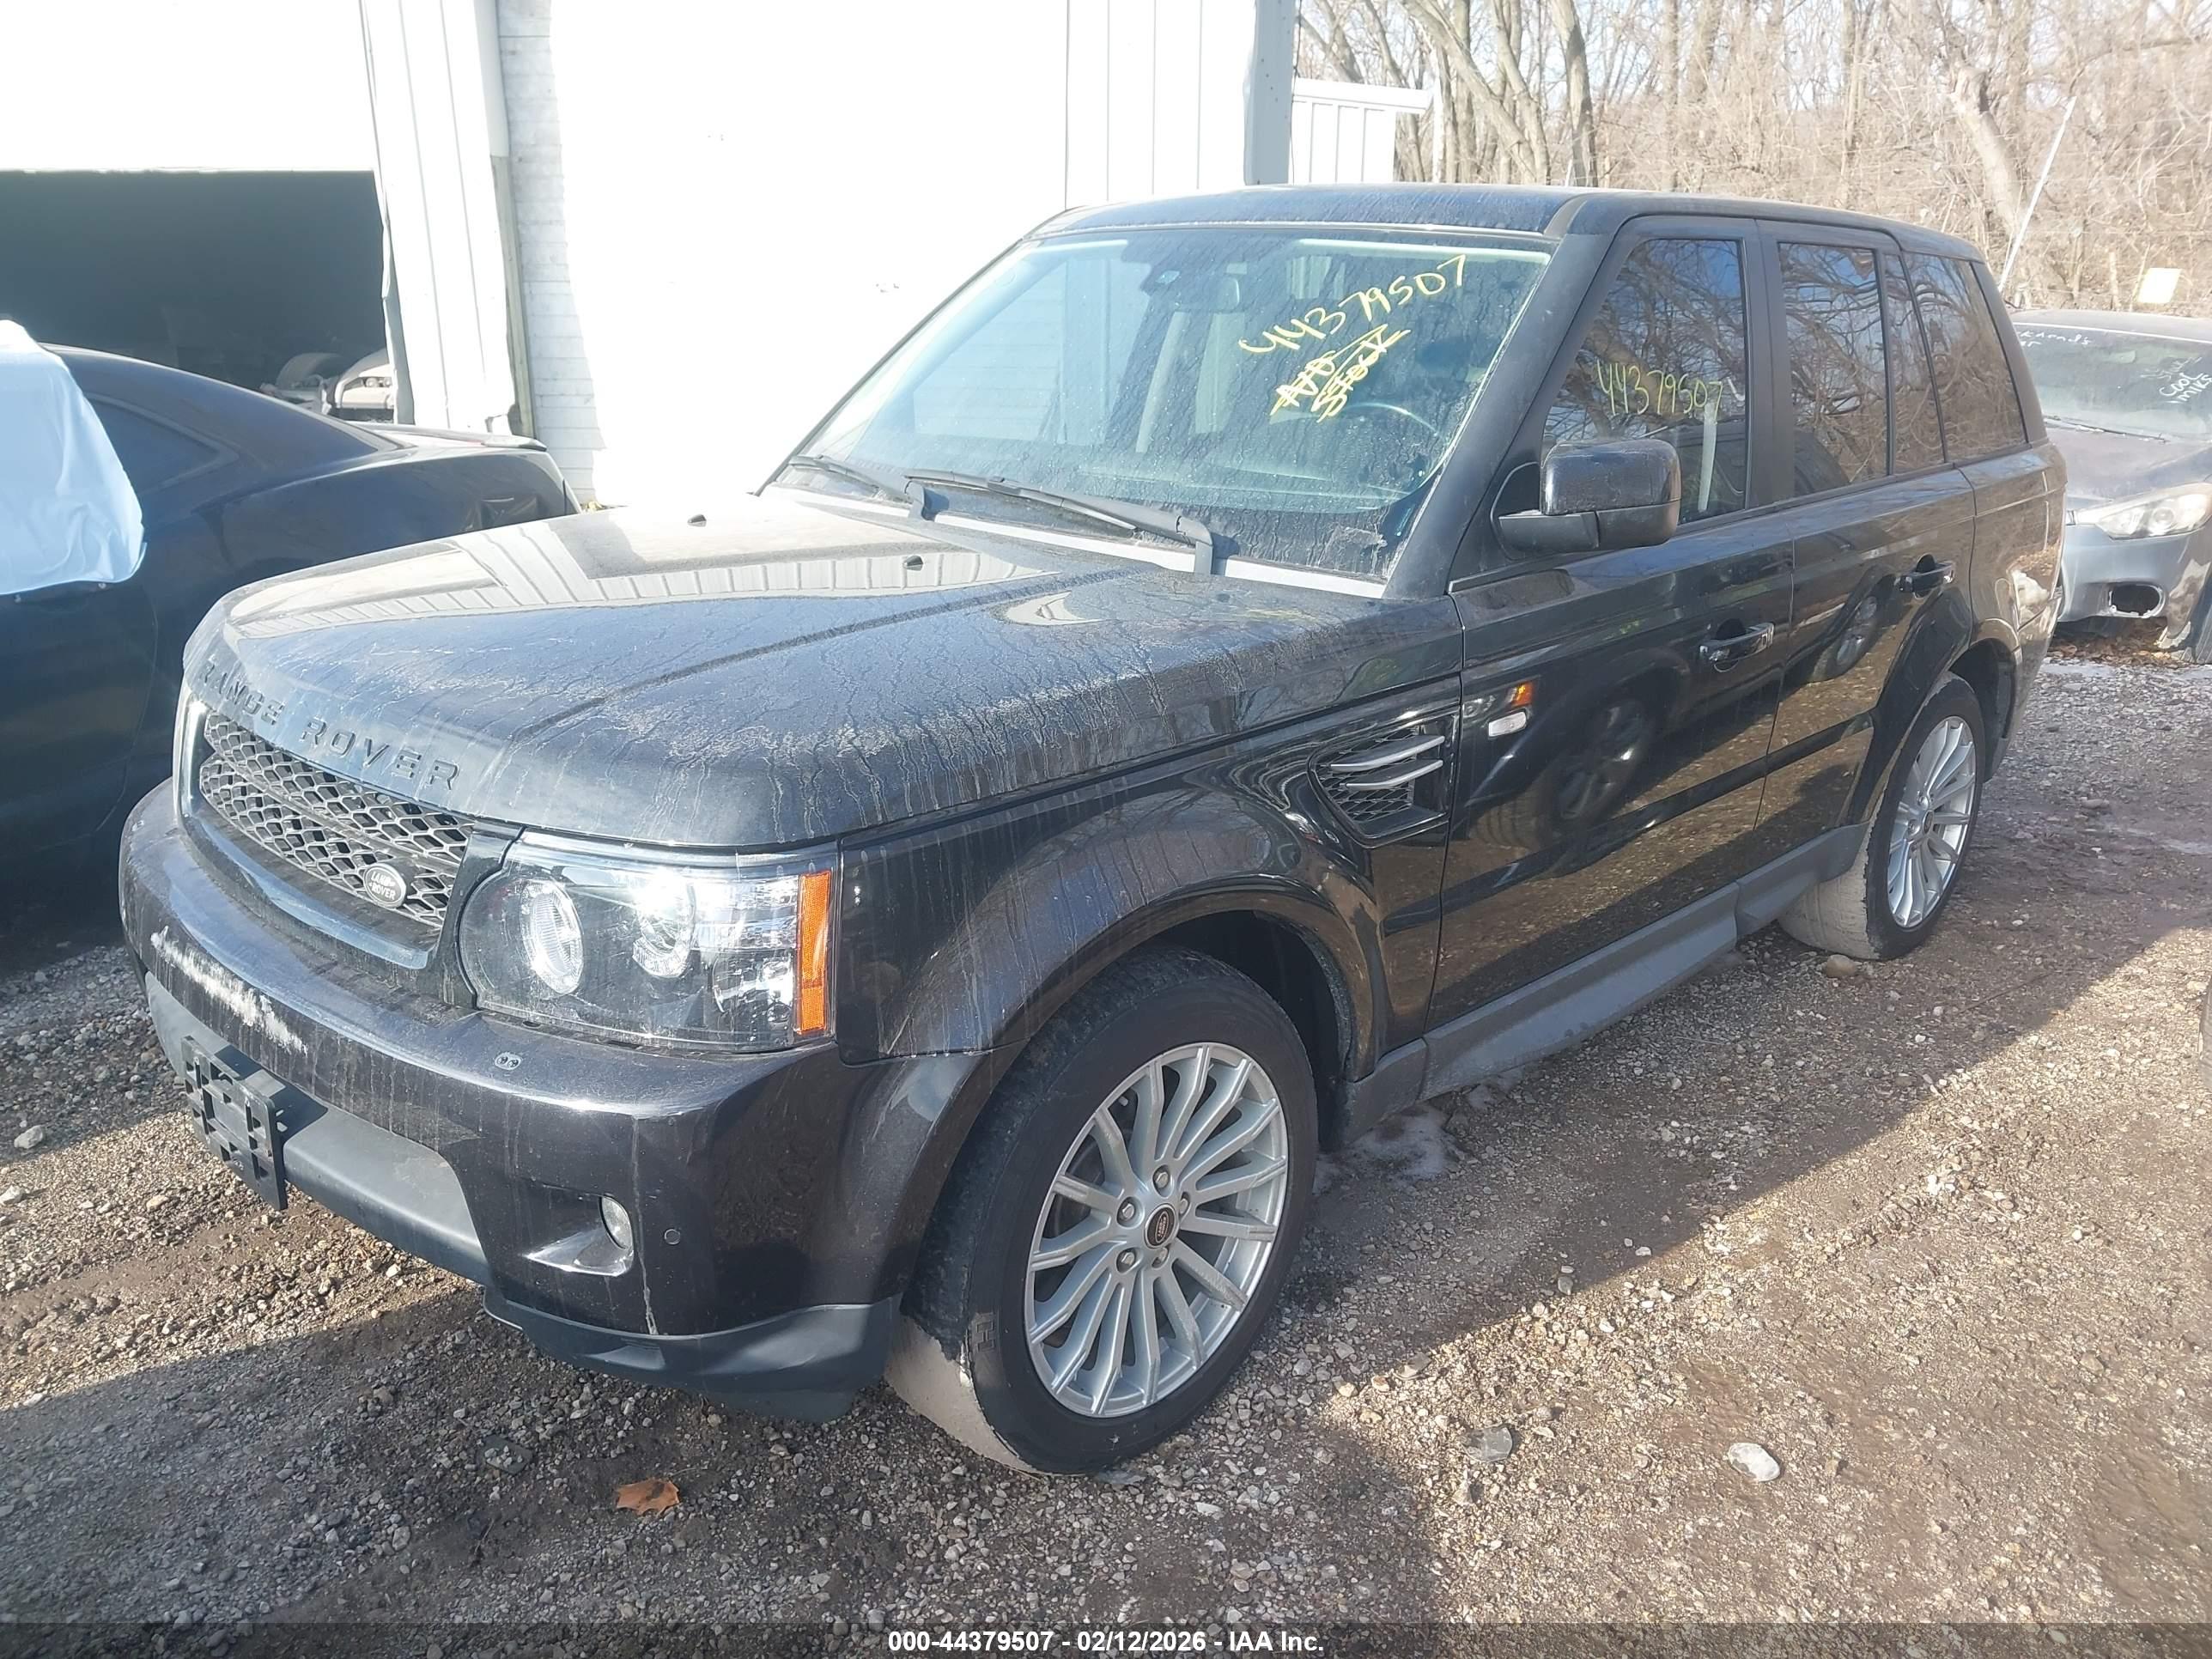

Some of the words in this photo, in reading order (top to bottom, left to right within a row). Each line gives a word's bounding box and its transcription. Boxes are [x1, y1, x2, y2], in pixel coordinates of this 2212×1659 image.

[1237, 253, 1466, 354] 44379507
[1596, 358, 1723, 425] 44379507
[301, 714, 460, 791] ROVER
[370, 871, 396, 888] LAND
[370, 882, 396, 901] ROVER
